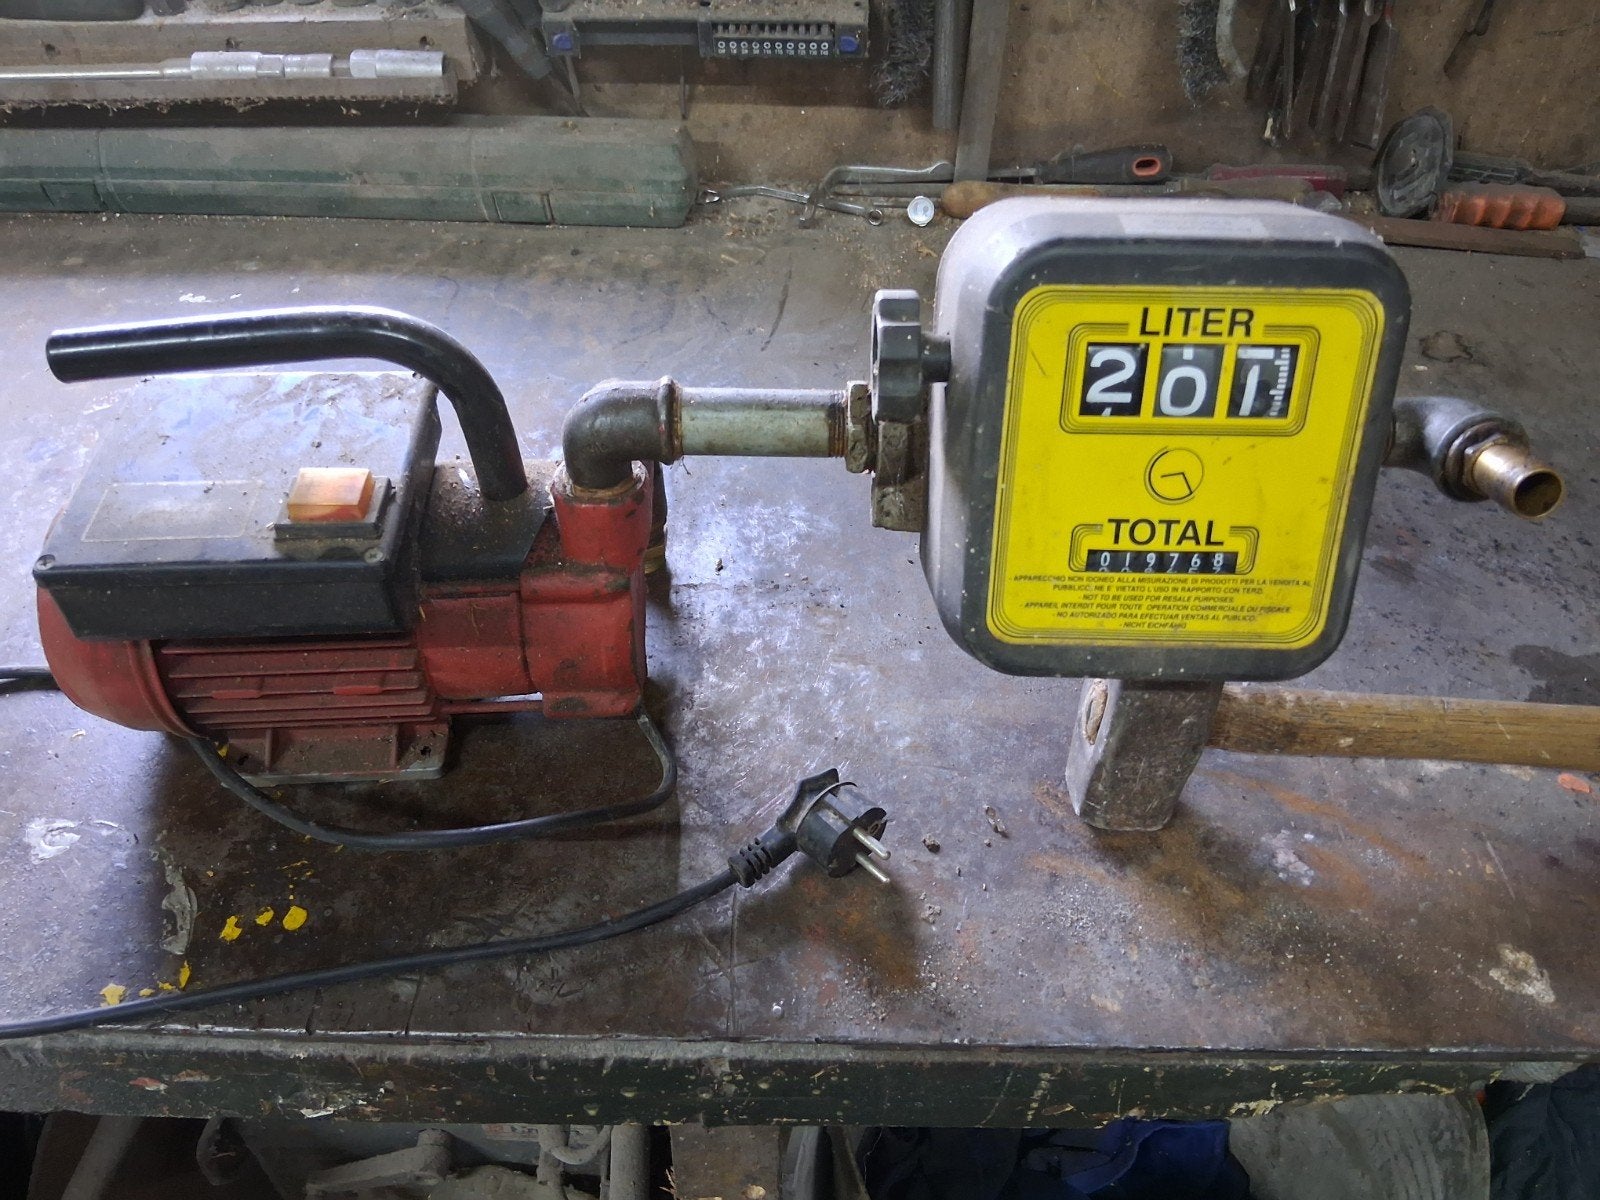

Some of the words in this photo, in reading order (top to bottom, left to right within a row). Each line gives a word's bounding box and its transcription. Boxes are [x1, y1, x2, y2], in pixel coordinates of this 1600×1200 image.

[1139, 307, 1255, 337] LITER
[1108, 519, 1224, 546] TOTAL
[1014, 575, 1066, 583] APPARECCHIO
[1138, 577, 1188, 585] MISURAZIONE
[1061, 602, 1095, 610] INTERDIT
[1119, 603, 1143, 611] TOUTE
[1146, 604, 1188, 612] OPERATION
[1190, 605, 1244, 613] COMMERCIALE
[1070, 611, 1117, 619] AUTORIZADO
[1181, 613, 1209, 621] VENTAS
[1123, 621, 1147, 629] NICHT
